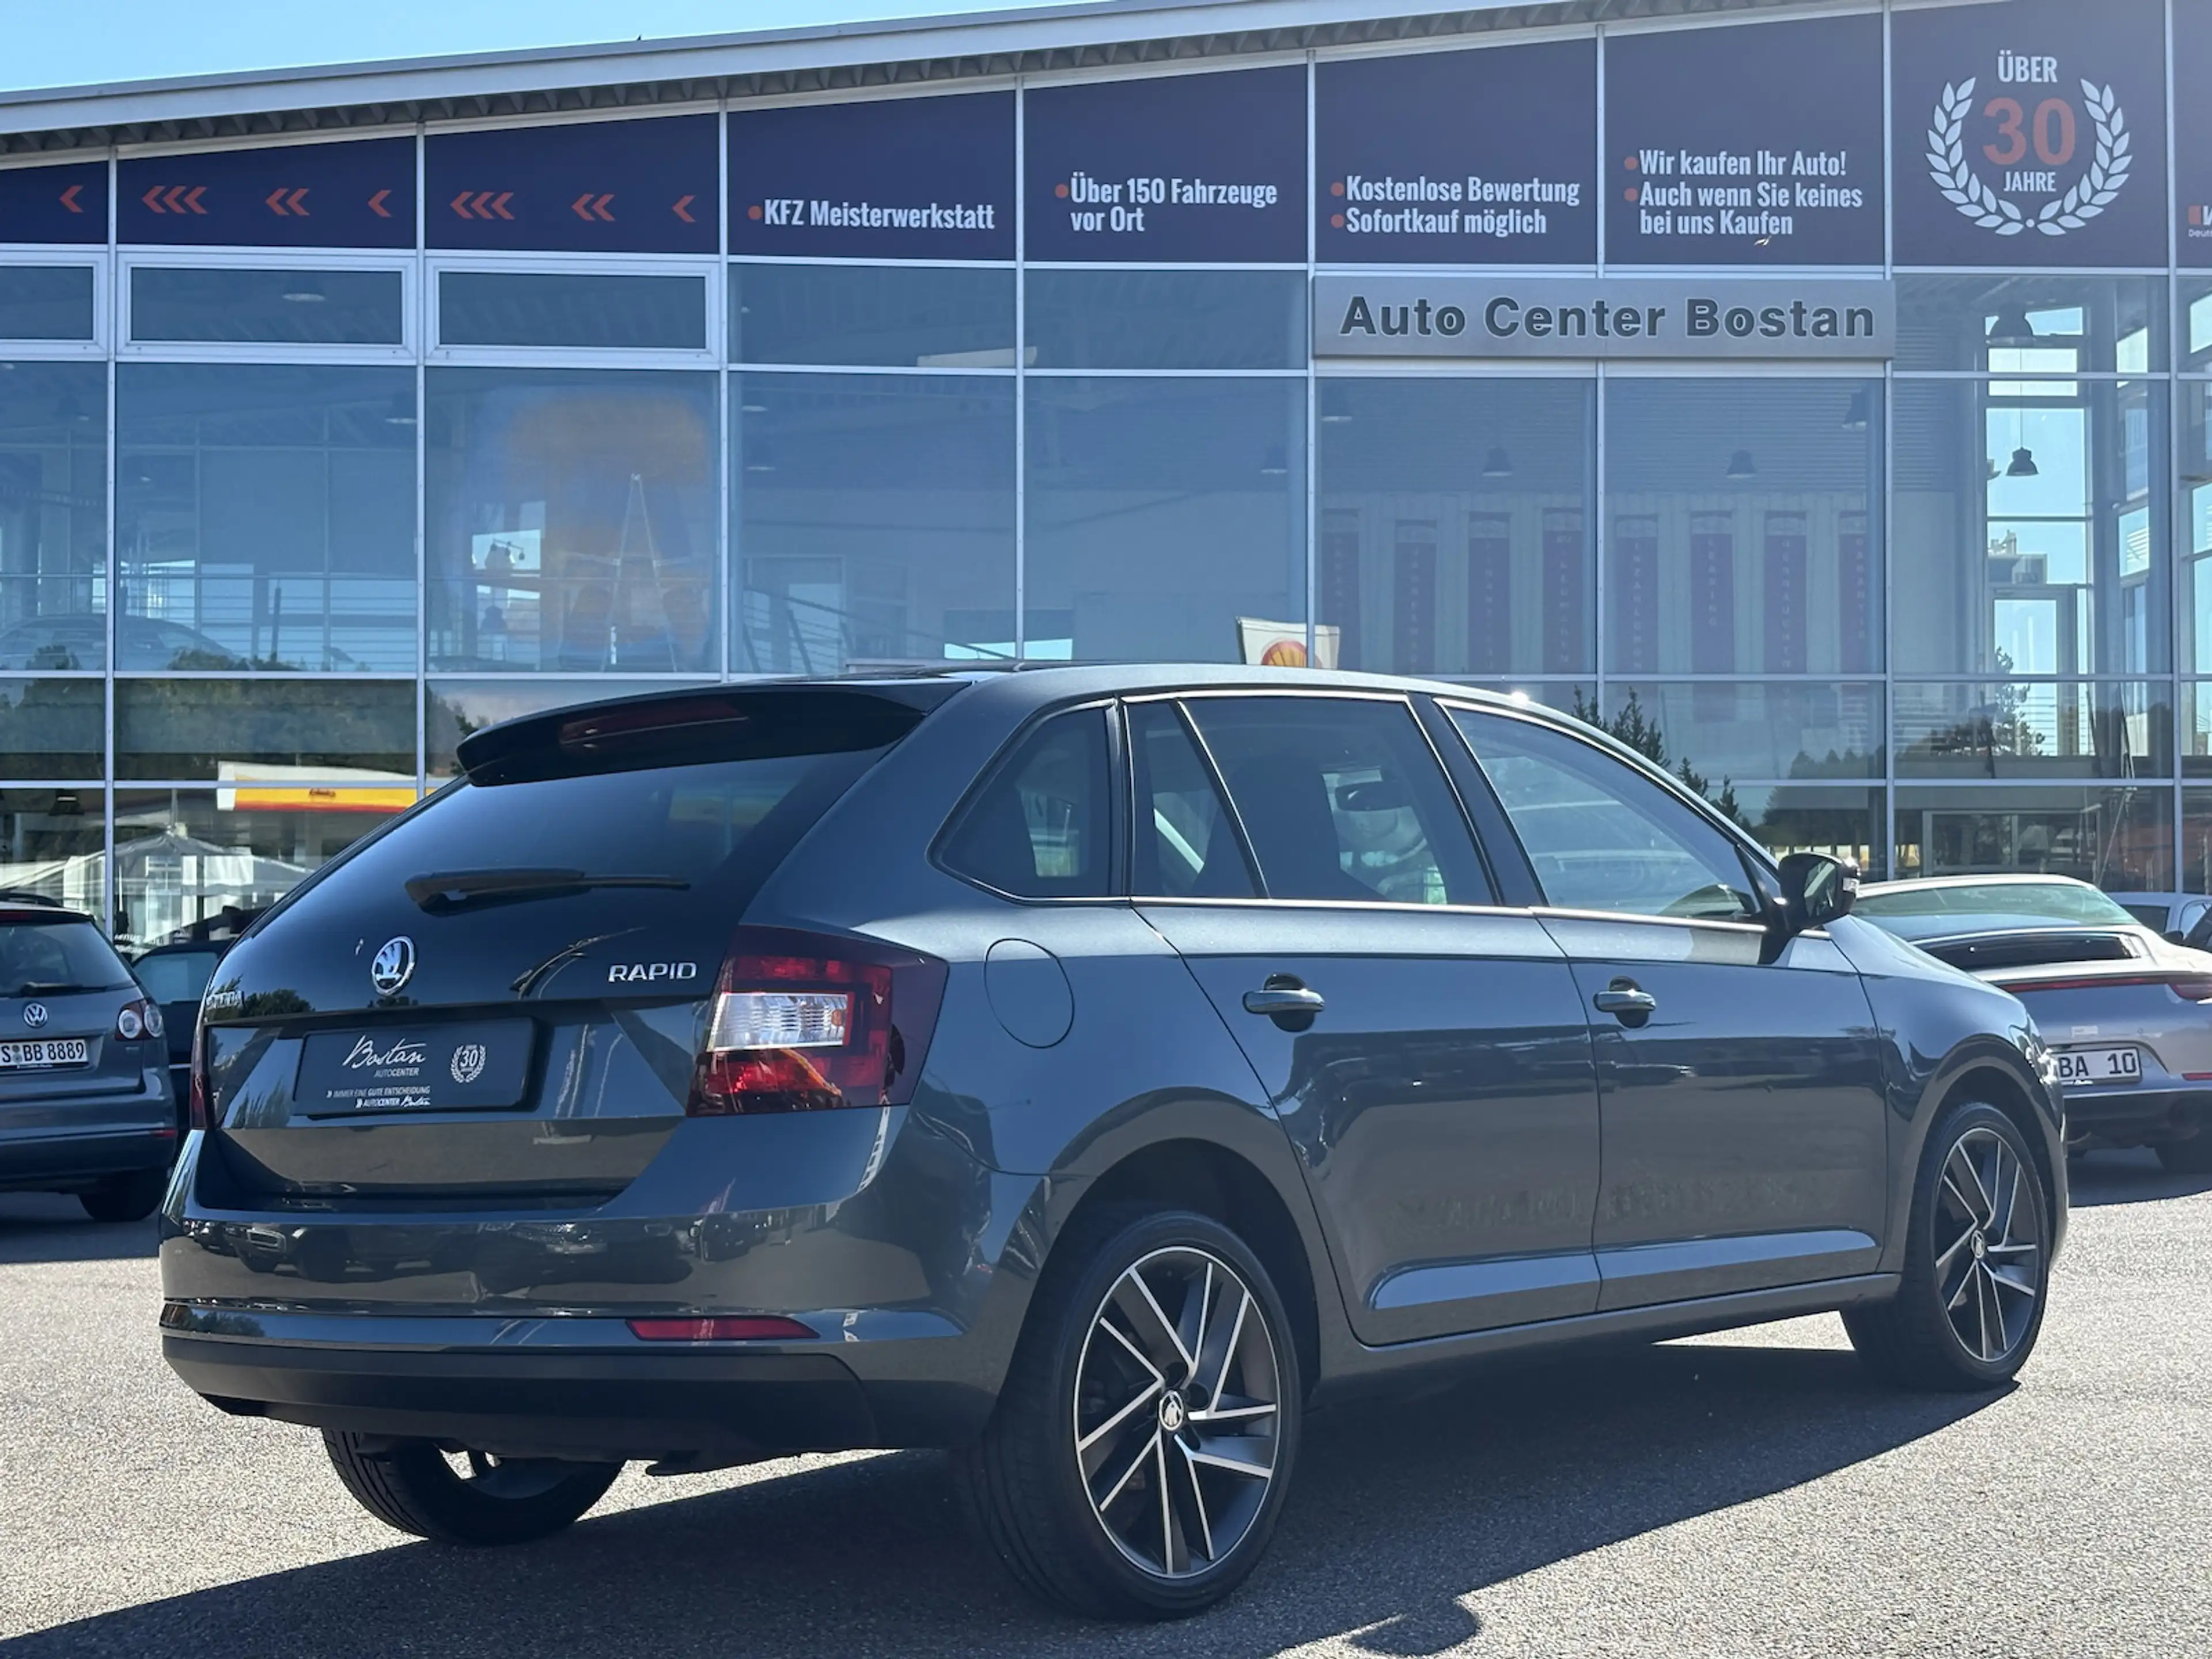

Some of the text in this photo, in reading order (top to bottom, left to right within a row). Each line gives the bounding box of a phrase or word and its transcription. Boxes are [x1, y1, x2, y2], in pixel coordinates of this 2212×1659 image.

[1998, 50, 2058, 83] ÜBER
[1983, 97, 2076, 165] 30
[1639, 149, 1847, 176] Wir kaufen Ihr Auto!
[1070, 171, 1278, 209] Über 150 Fahrzeuge
[1346, 175, 1581, 207] Kostenlose Bewertung
[1639, 181, 1863, 208] Auch wenn Sie keines
[2003, 171, 2057, 192] JAHRE
[764, 199, 995, 230] KFZ Meisterwerkstatt
[1070, 205, 1145, 232] vor Ort
[1346, 207, 1547, 238] Sofortkauf möglich
[1640, 209, 1793, 235] bei uns Kaufen
[1339, 296, 1875, 338] Auto Center Bostan
[608, 962, 697, 983] RAPID
[1, 1042, 85, 1063] S BB 8889
[342, 1035, 426, 1070] Bostan
[460, 1050, 479, 1067] 30
[2058, 1052, 2137, 1078] BA 10
[374, 1067, 420, 1078] AUTOCENTER
